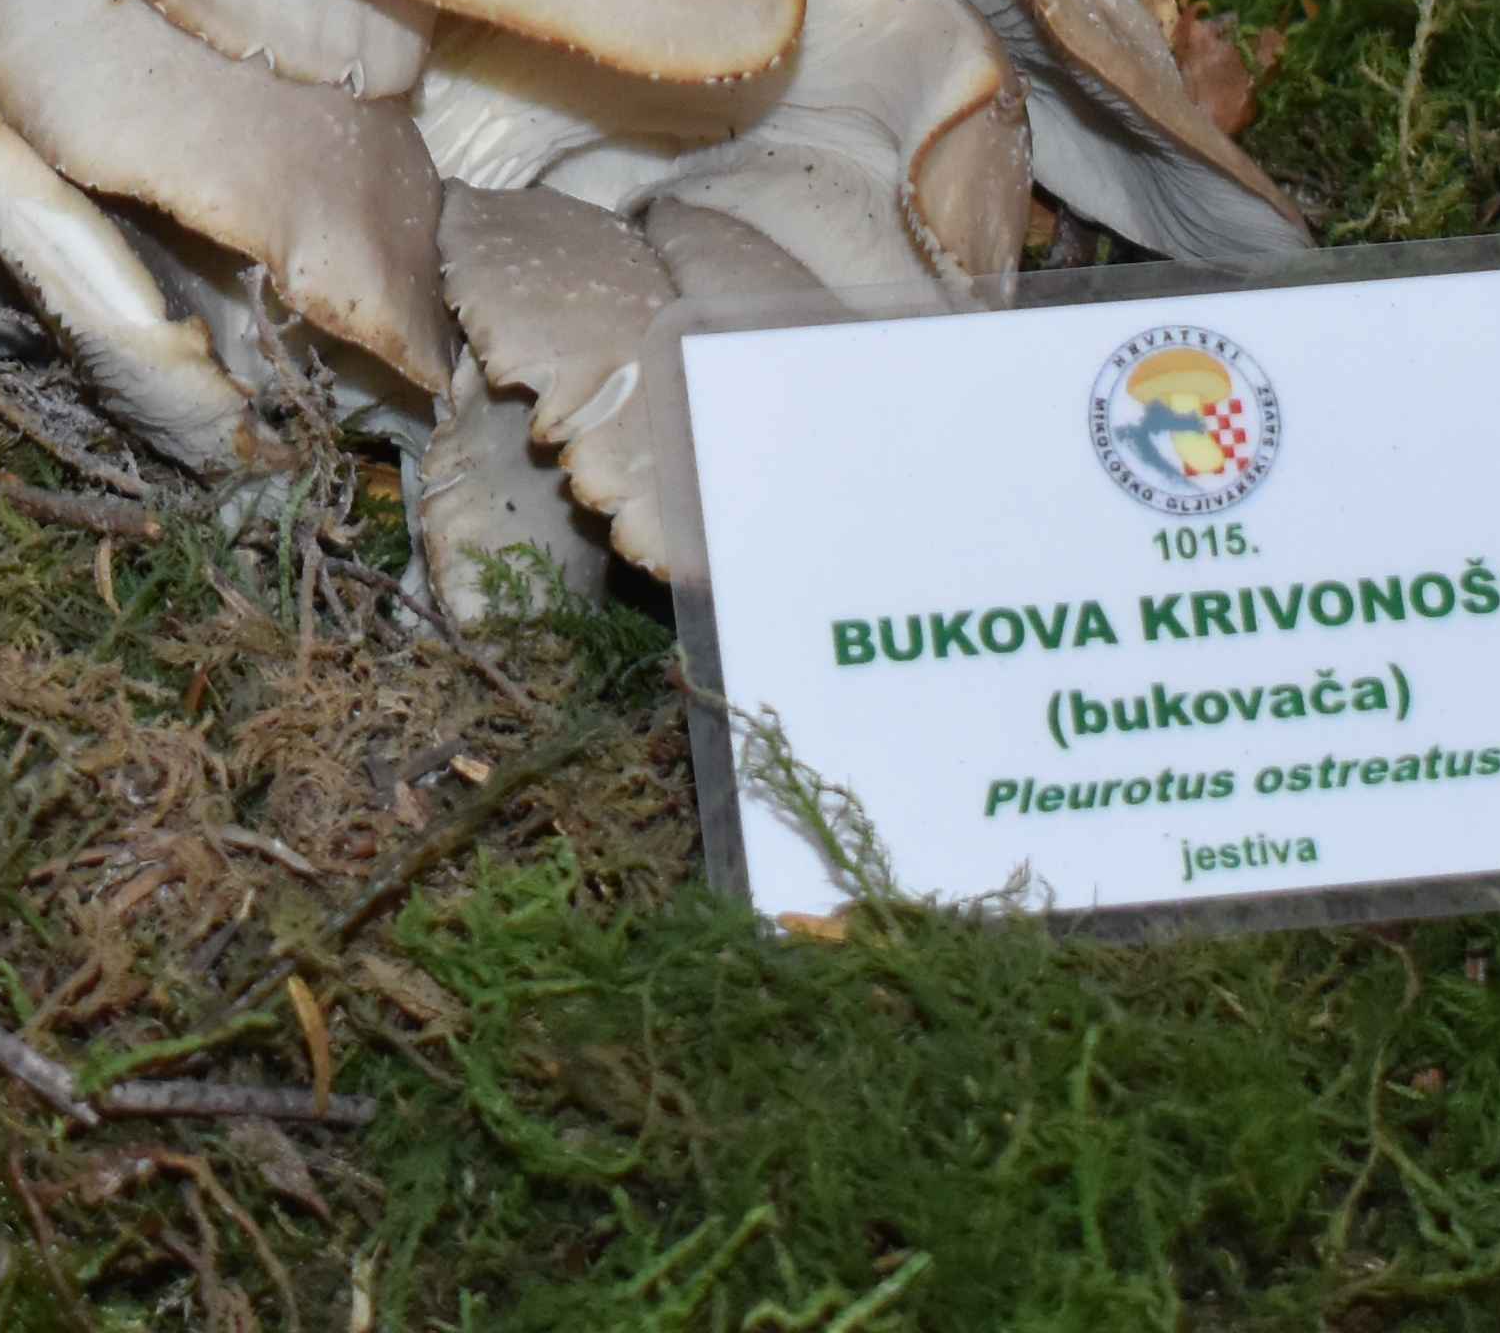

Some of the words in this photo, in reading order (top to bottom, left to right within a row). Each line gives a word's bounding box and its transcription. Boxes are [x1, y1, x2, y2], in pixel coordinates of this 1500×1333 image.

[1112, 329, 1241, 368] HRVATSKI
[1152, 522, 1260, 561] 1015.
[832, 599, 1118, 666] BUKOVA
[1046, 663, 1412, 748] (bukovača)
[984, 766, 1235, 817] Pleurotus
[1181, 833, 1319, 884] jestiva
